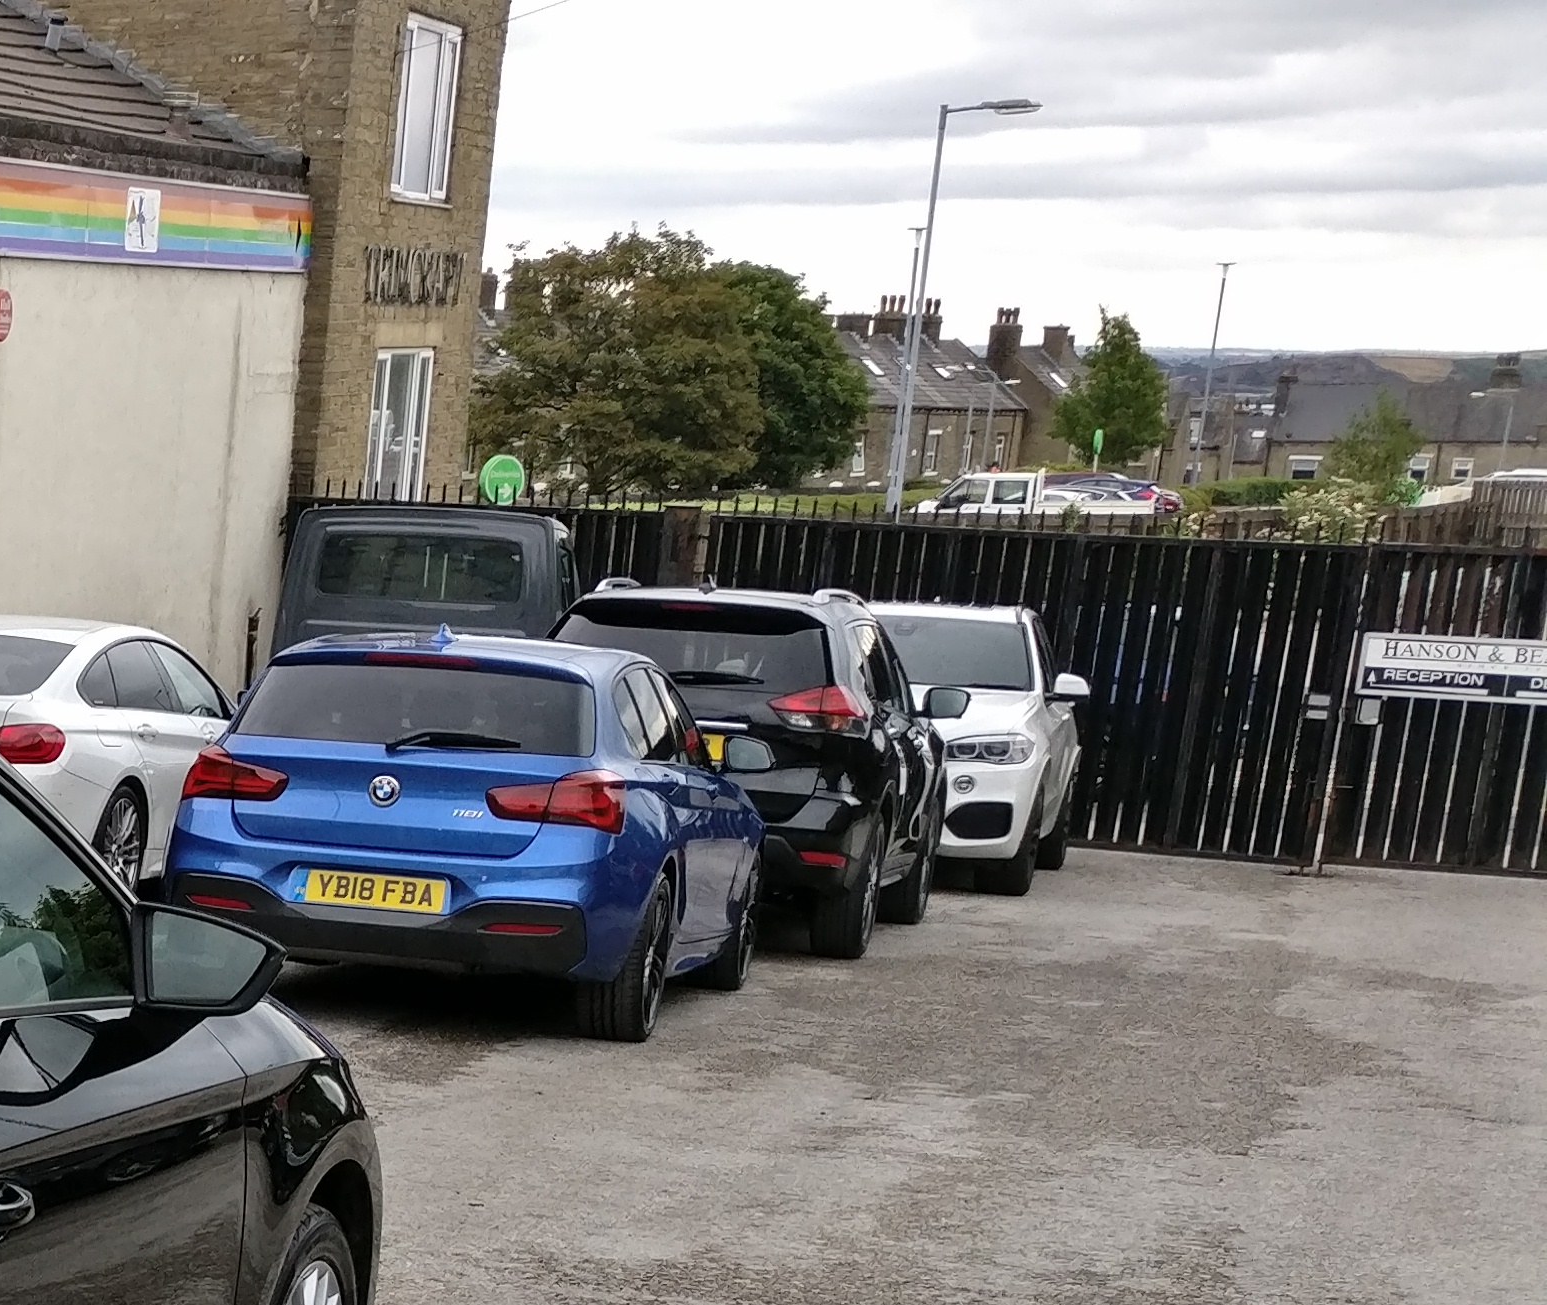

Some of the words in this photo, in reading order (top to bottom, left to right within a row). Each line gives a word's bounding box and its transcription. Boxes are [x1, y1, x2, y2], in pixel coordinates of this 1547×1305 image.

[1383, 640, 1480, 660] HANSON
[1488, 645, 1505, 663] &
[1513, 646, 1547, 664] BE
[1383, 668, 1485, 686] RECEPTION
[318, 873, 376, 901] YB18
[382, 879, 433, 907] FBA
